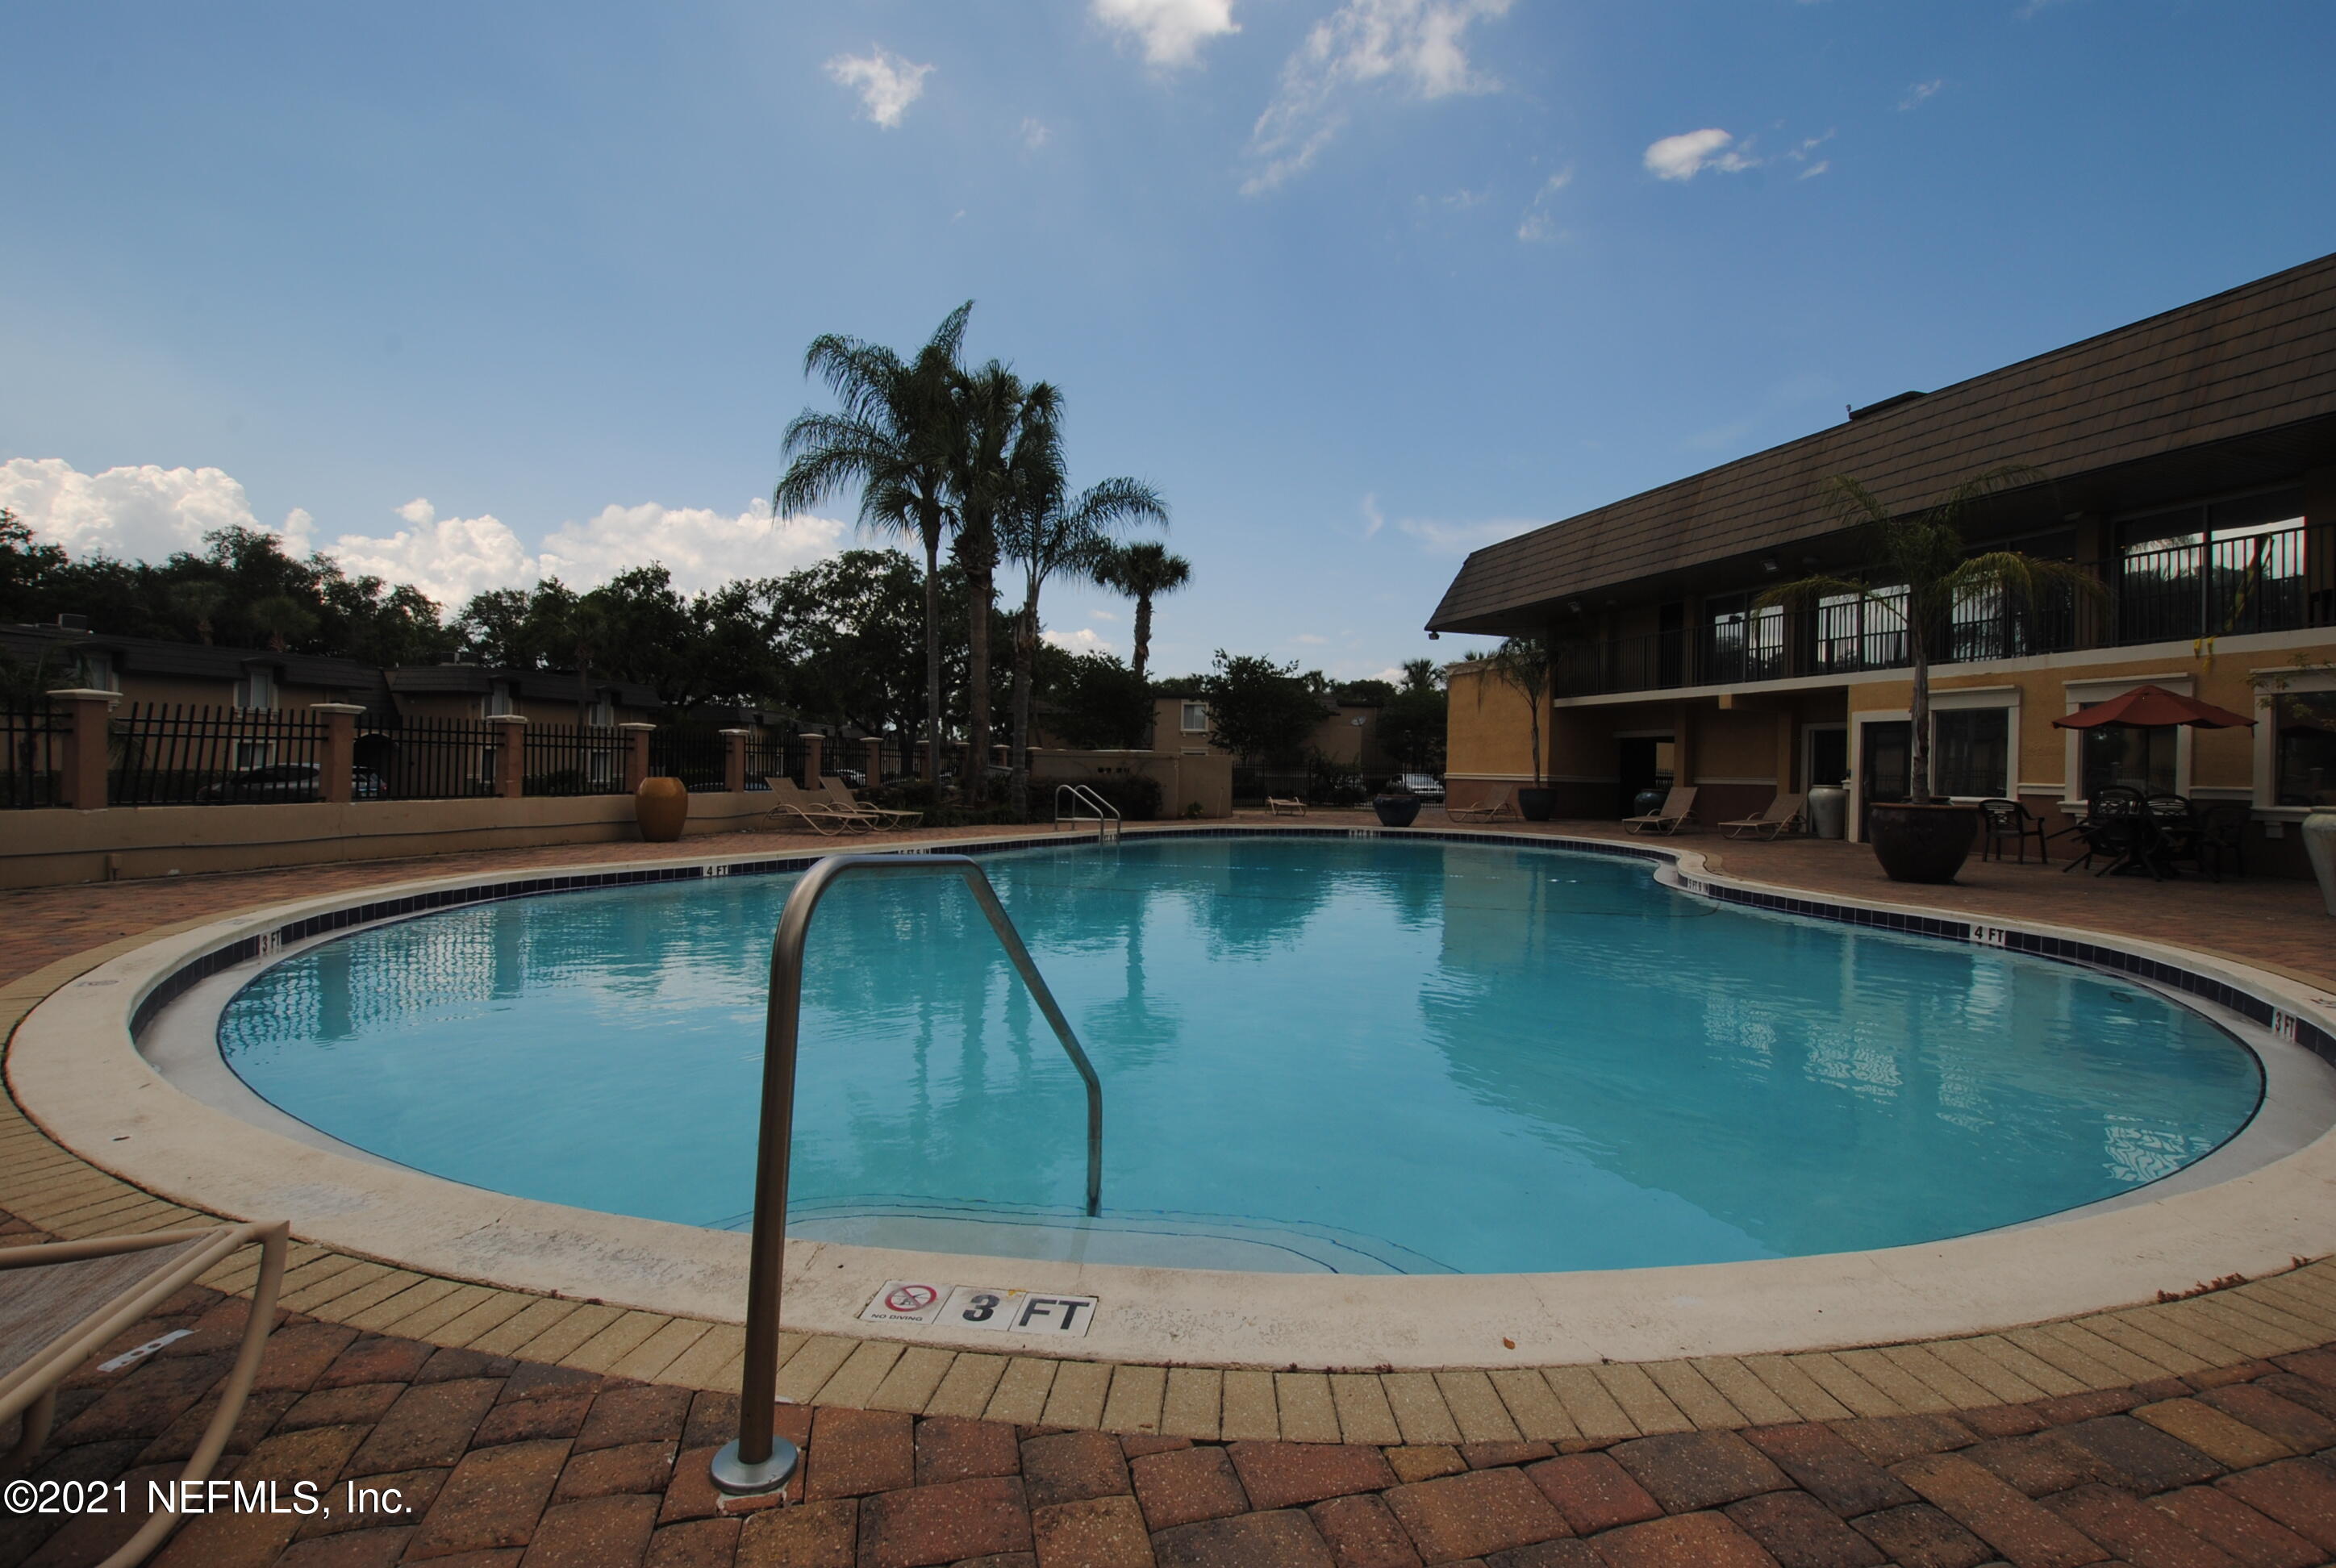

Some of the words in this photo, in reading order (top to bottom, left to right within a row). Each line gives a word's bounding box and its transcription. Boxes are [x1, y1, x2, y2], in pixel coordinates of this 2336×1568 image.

[707, 866, 712, 876] 4
[716, 865, 727, 876] FT
[1692, 880, 1698, 890] FT
[262, 935, 268, 953] 3
[271, 929, 281, 949] FT
[1974, 926, 1983, 939] 4
[1988, 928, 2004, 942] FT
[2276, 1011, 2281, 1032] 3
[2284, 1015, 2295, 1038] FT
[962, 1294, 1000, 1321] 3
[1018, 1298, 1090, 1330] FT
